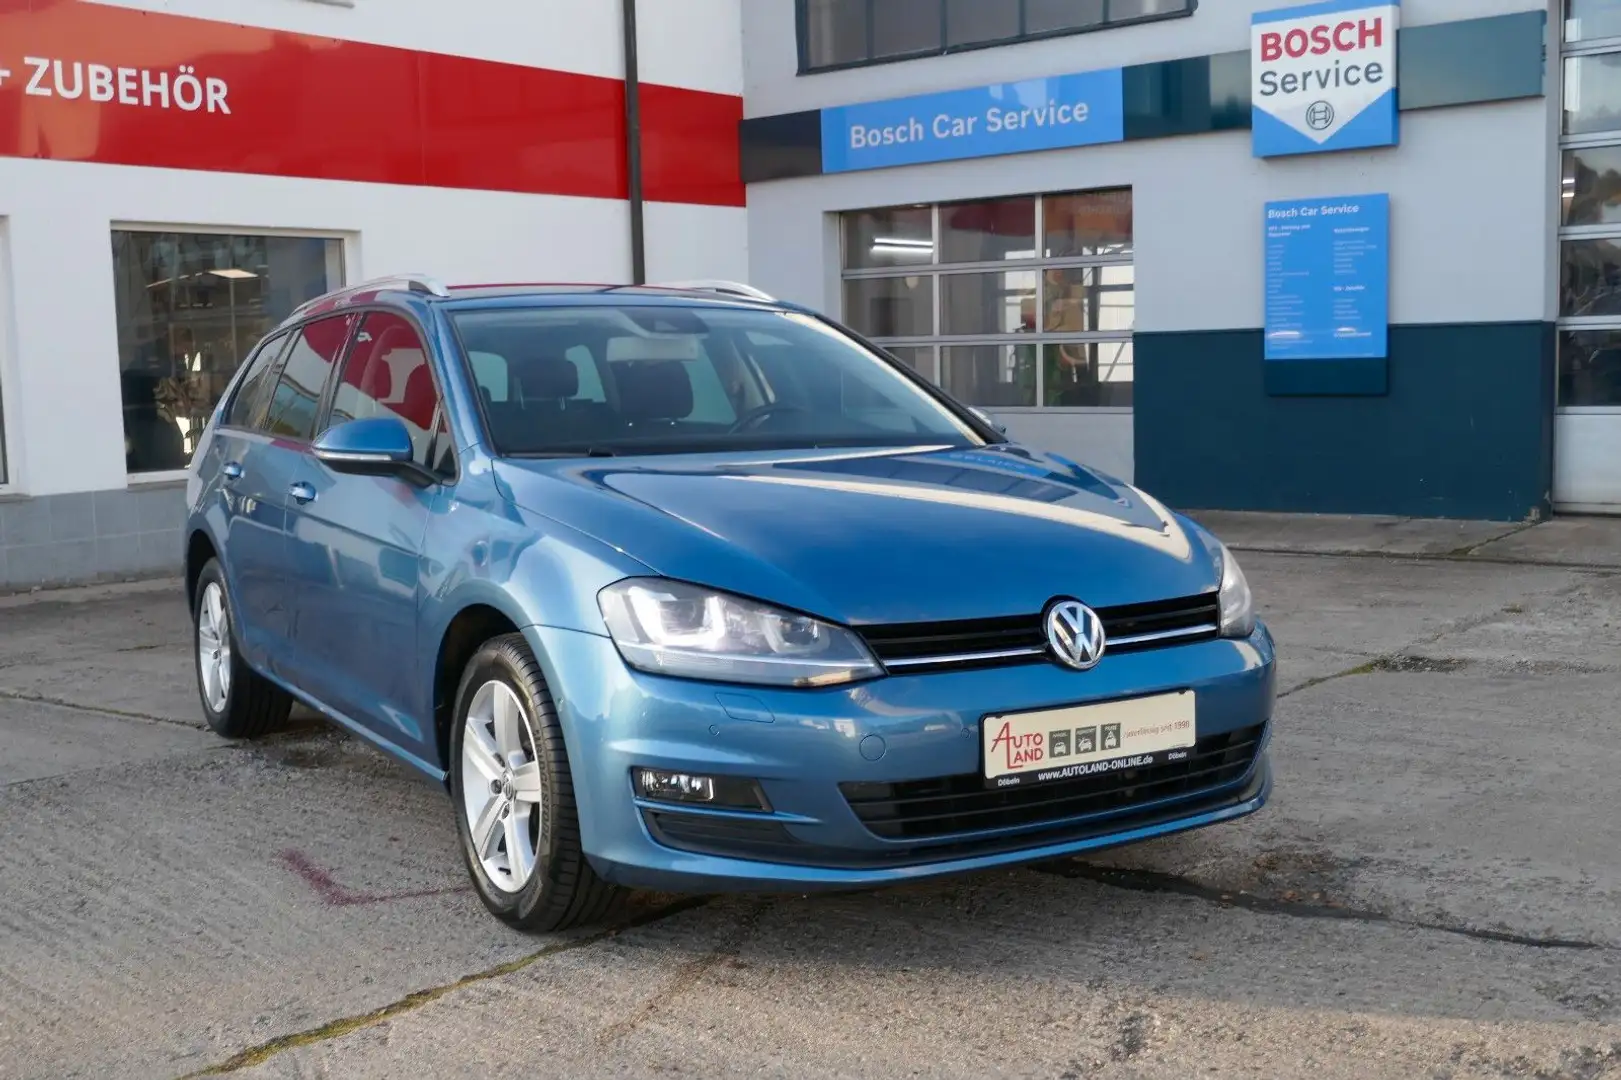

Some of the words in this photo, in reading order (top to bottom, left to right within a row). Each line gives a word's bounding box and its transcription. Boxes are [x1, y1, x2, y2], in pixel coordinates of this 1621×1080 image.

[1260, 17, 1382, 62] BOSCH
[23, 56, 232, 115] ZUBEHÖR
[1259, 59, 1383, 96] Service
[850, 117, 924, 149] Bosch
[932, 113, 977, 139] Car
[986, 99, 1089, 133] Service
[1267, 207, 1298, 219] Bosch
[1300, 206, 1318, 217] Car
[1320, 203, 1359, 216] Service
[1038, 755, 1153, 780] www.AUTOLAND-ONLINE.de
